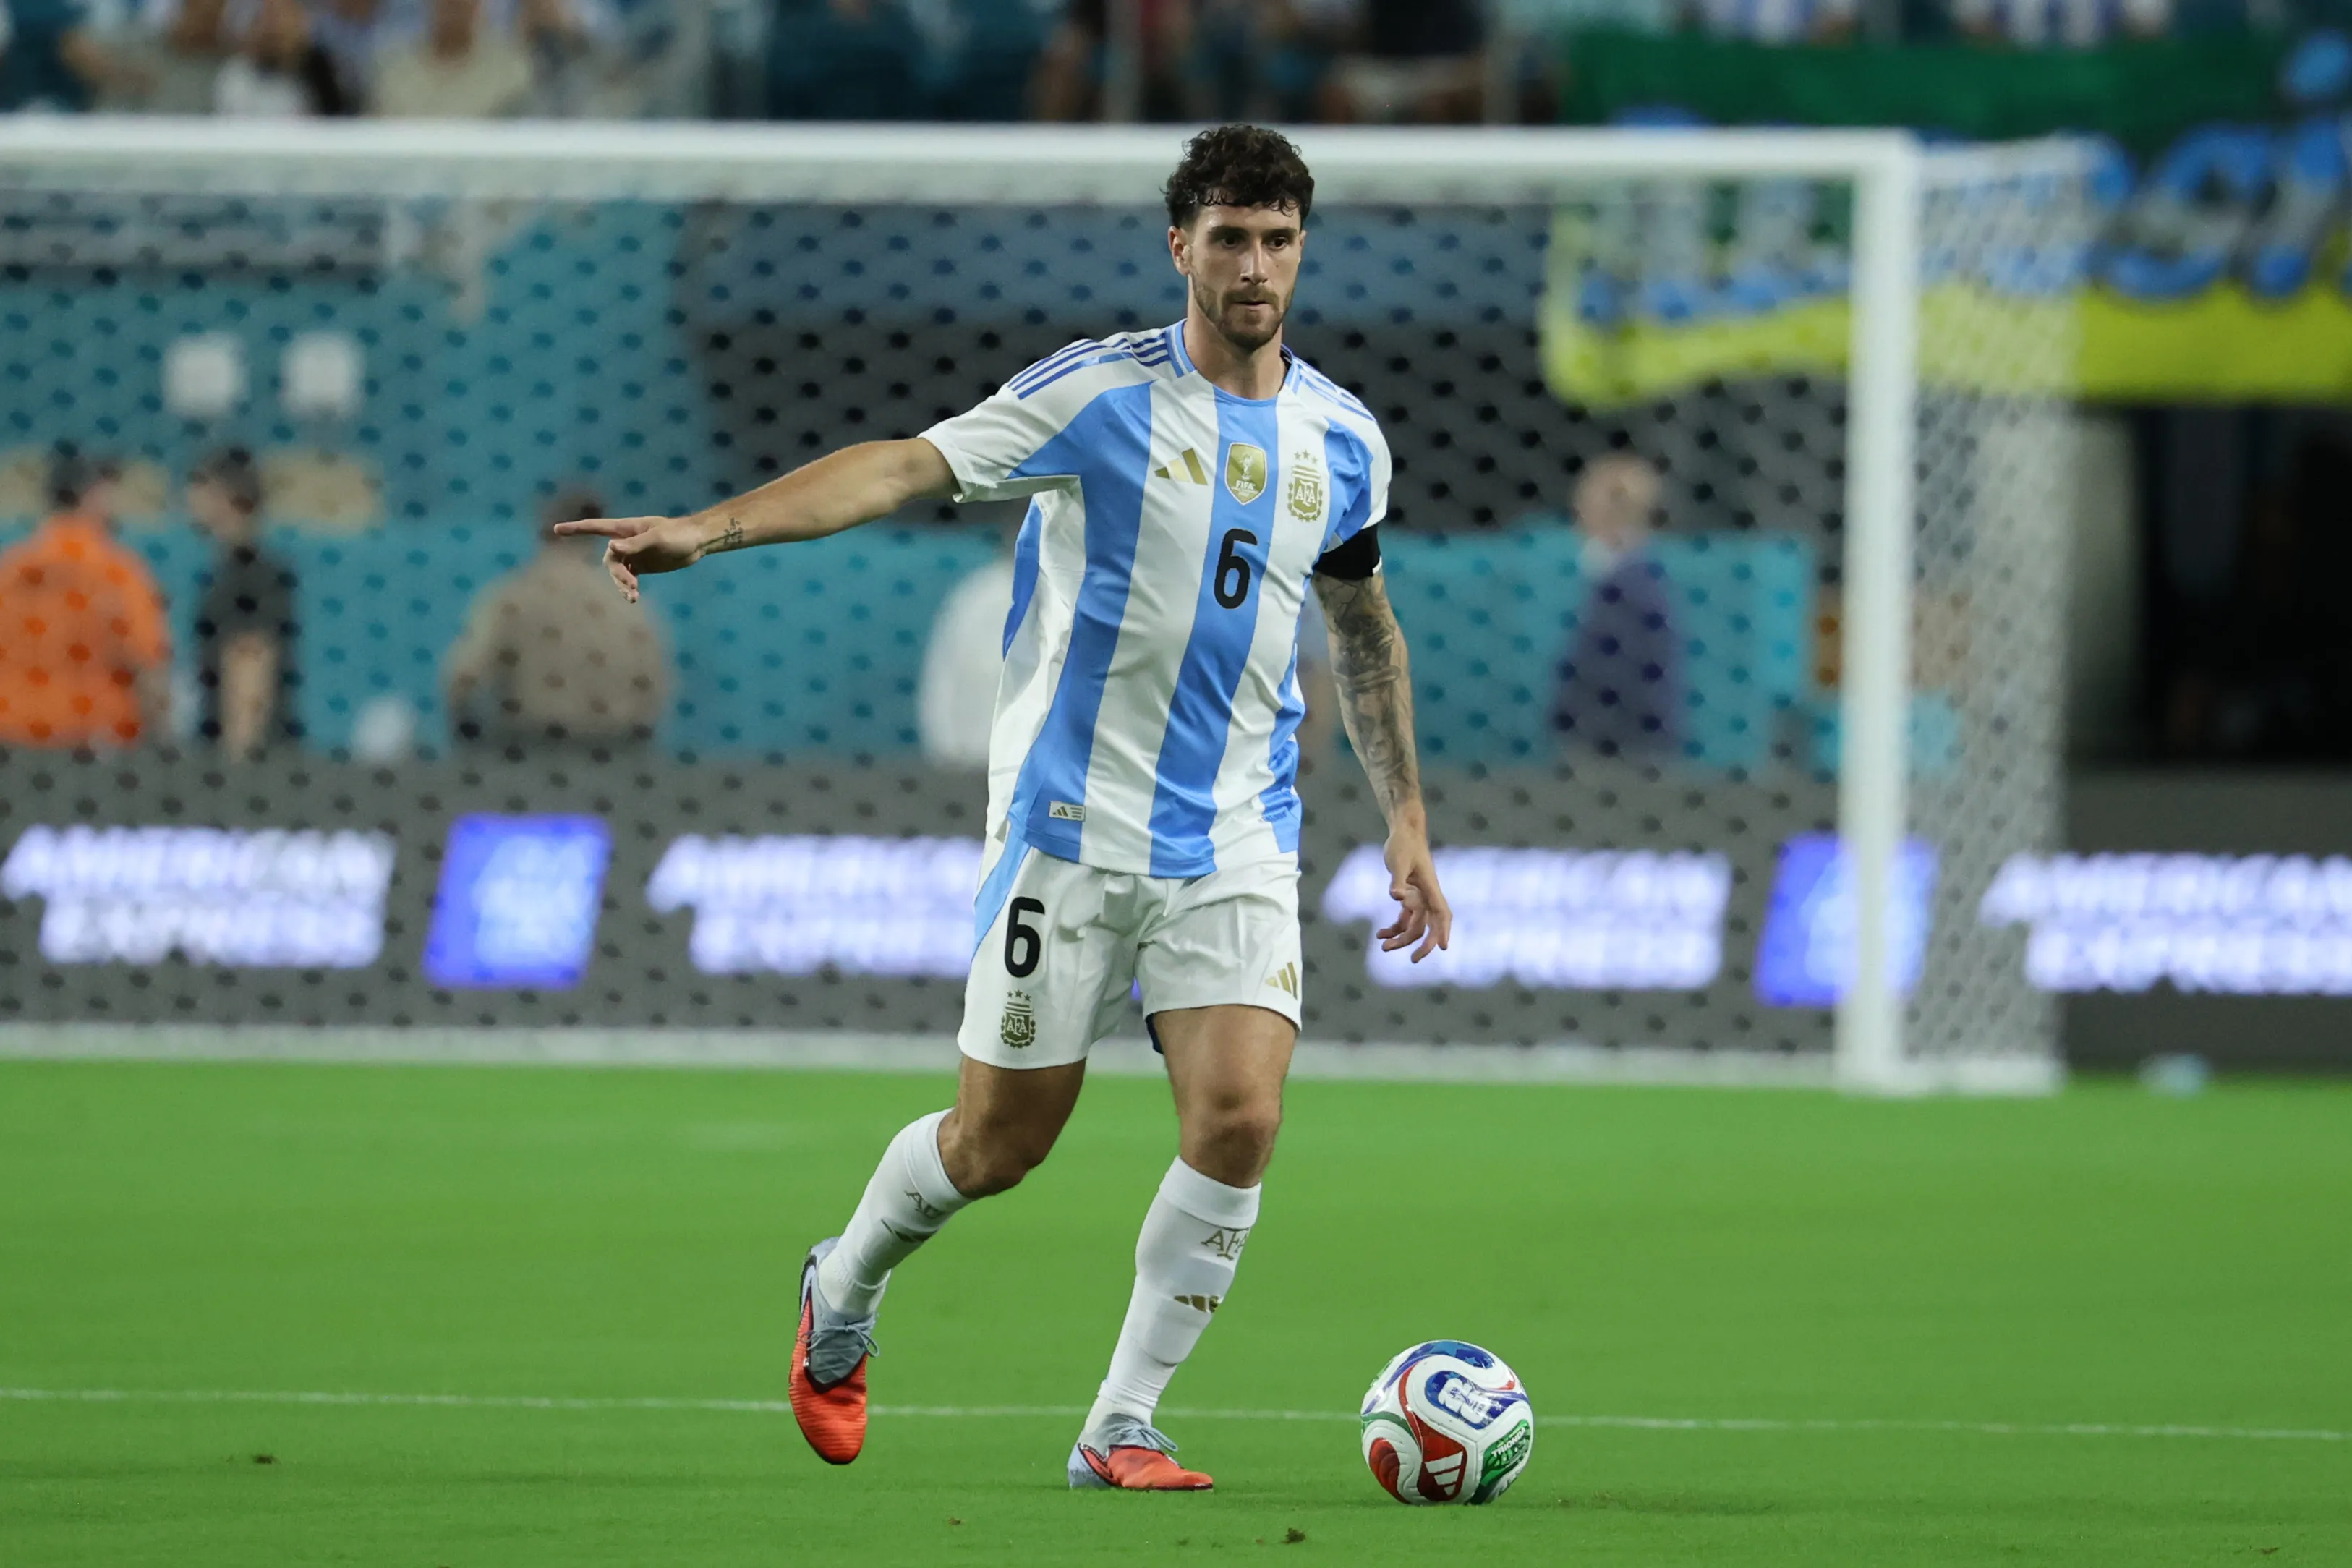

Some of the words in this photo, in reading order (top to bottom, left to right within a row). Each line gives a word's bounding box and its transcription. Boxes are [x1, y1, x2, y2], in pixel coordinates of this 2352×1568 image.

[1236, 480, 1254, 490] FIFA
[1295, 479, 1316, 507] AFA
[1214, 528, 1258, 609] 6
[1004, 896, 1045, 978] 6
[1006, 1013, 1028, 1036] AFA
